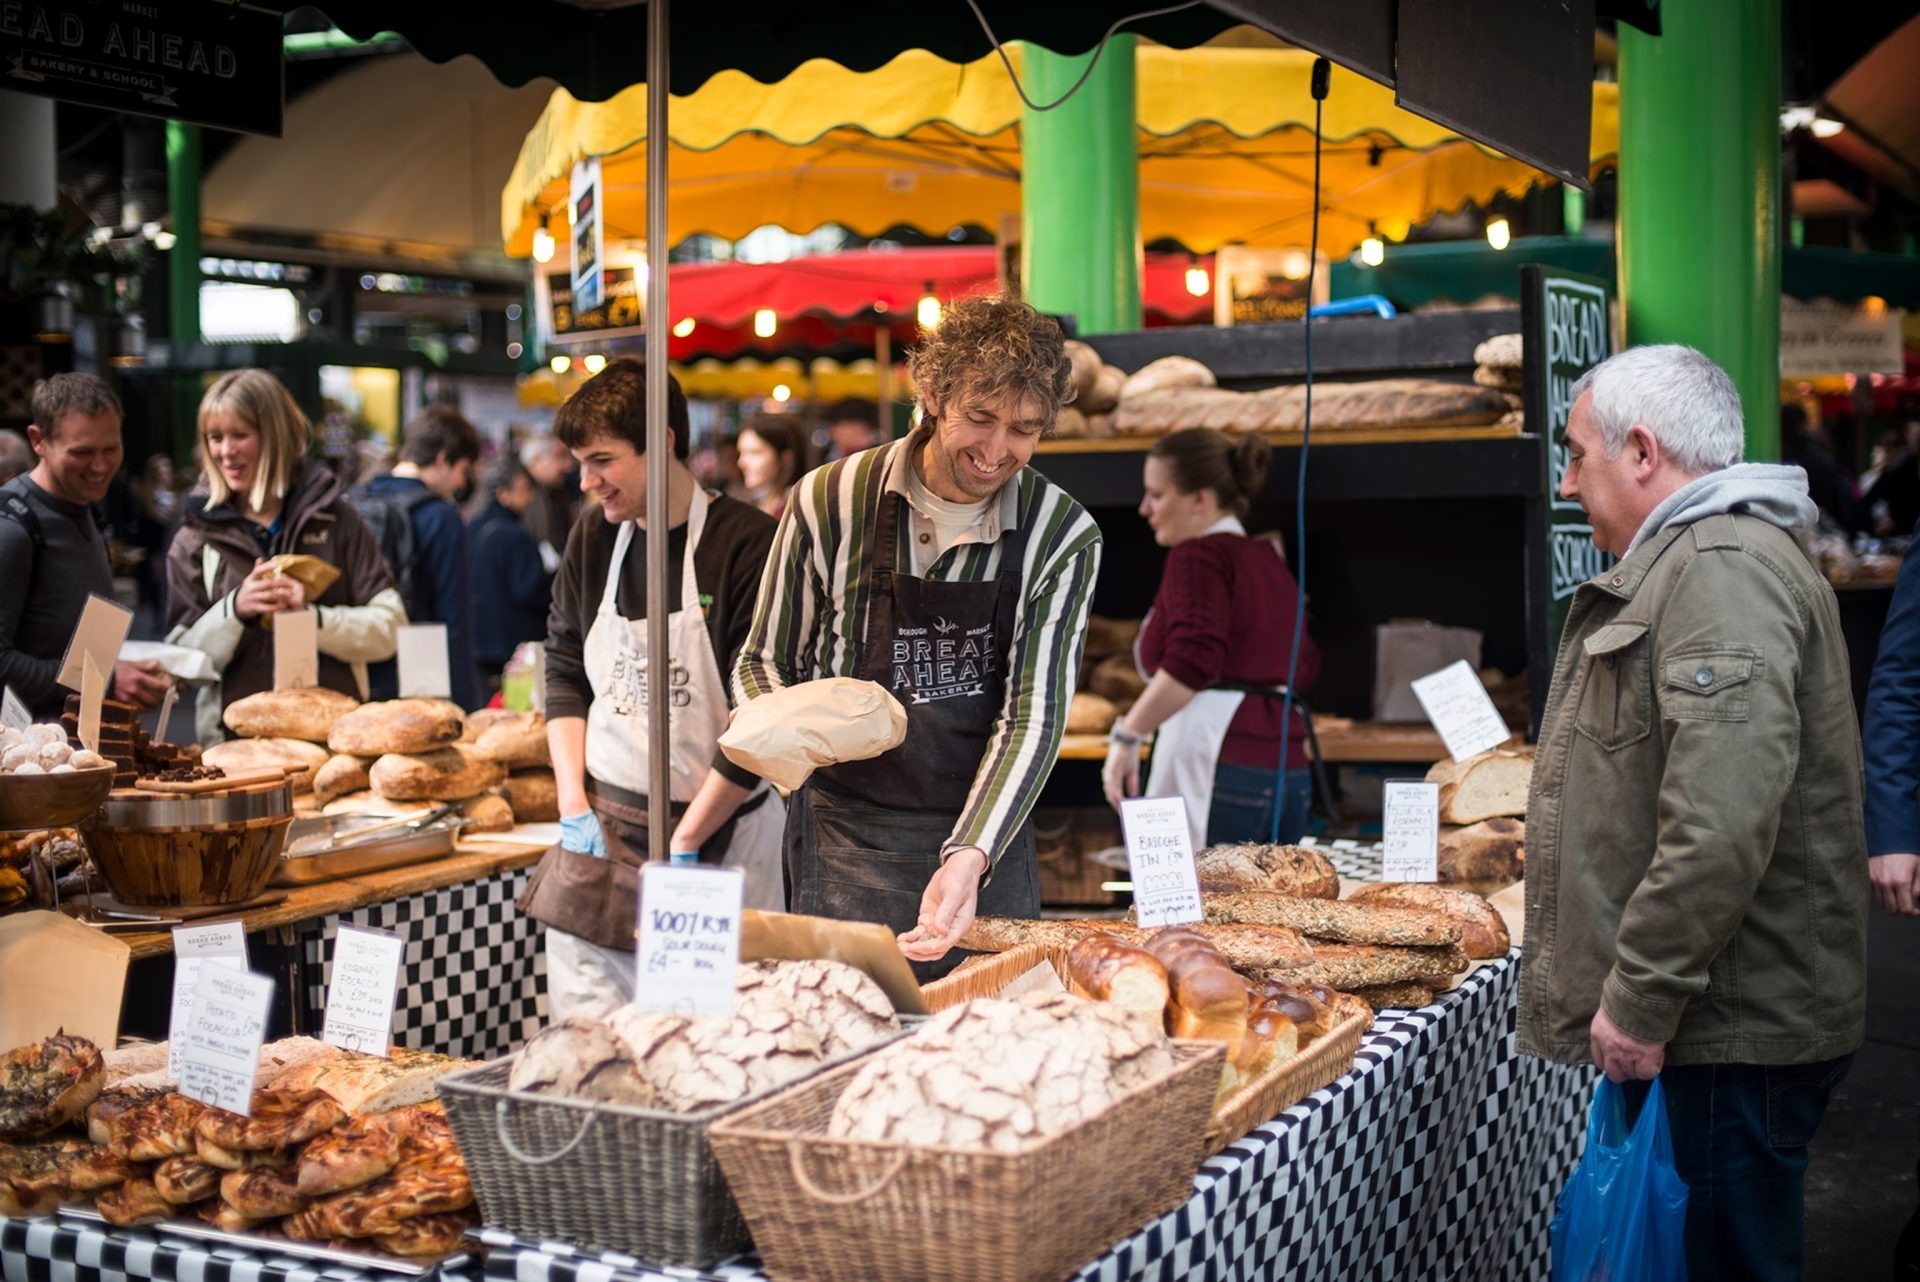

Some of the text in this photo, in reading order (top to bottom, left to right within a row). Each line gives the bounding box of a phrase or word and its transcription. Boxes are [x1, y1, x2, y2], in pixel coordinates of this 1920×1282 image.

[122, 1, 161, 18] MARKET
[102, 22, 237, 79] AHEAD
[30, 56, 157, 89] BAKERY & SCHOOL
[1549, 290, 1605, 367] BREAD
[1553, 532, 1605, 586] SCHOO
[898, 627, 928, 636] BOROUGH
[610, 660, 690, 687] BED
[602, 681, 692, 707] AHED
[924, 685, 971, 698] BAKERY
